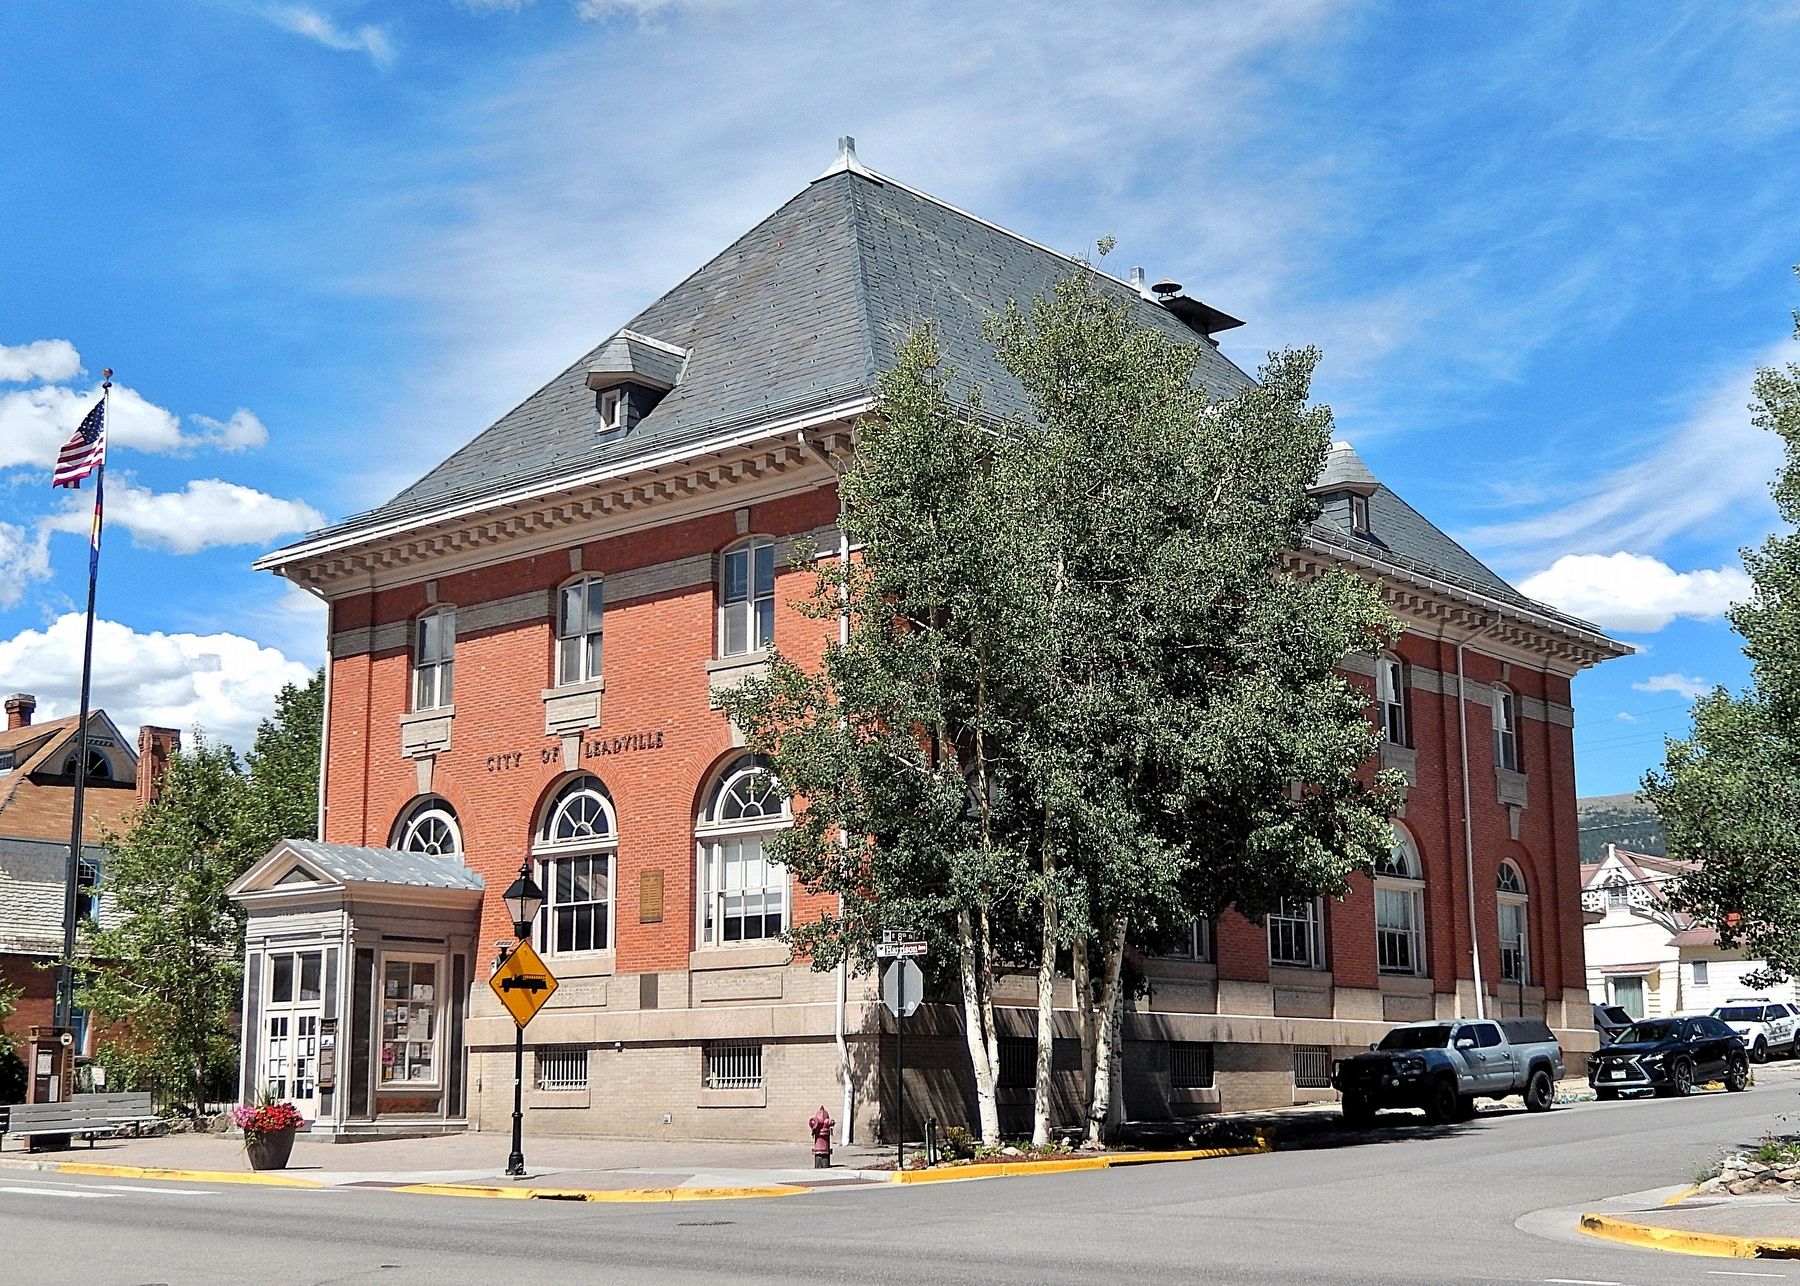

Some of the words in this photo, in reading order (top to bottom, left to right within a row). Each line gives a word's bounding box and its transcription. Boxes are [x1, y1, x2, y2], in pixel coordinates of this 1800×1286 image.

[487, 752, 522, 772] CITY
[542, 747, 560, 764] OF
[585, 731, 663, 759] LEADVILLE
